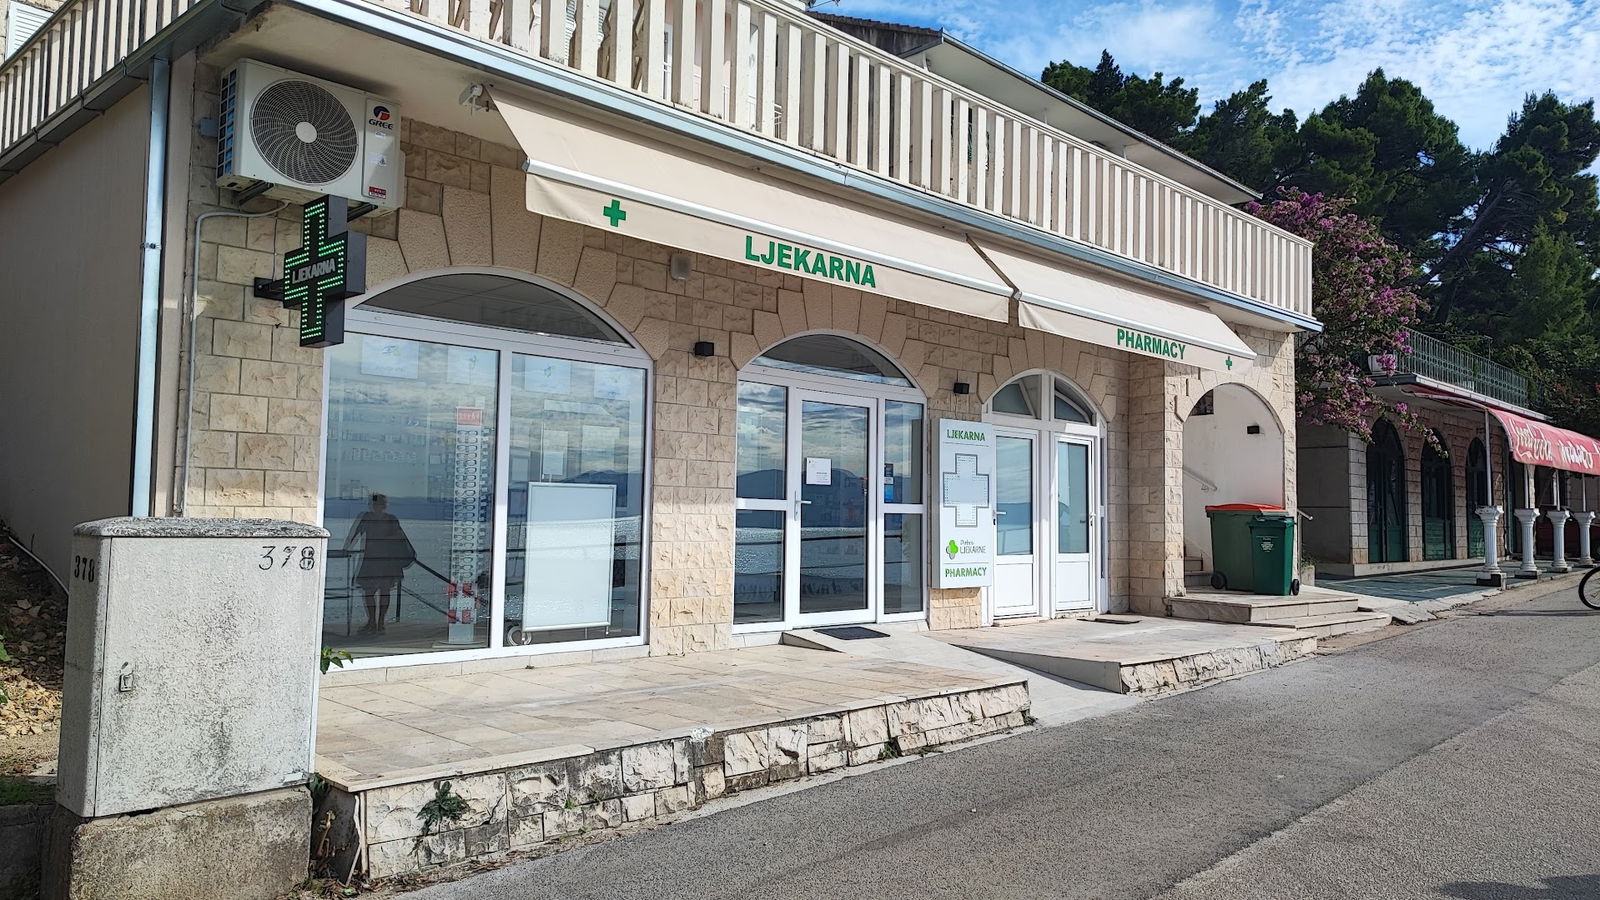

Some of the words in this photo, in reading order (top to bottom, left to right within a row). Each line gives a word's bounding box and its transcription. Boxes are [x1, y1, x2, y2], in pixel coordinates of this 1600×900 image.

[368, 118, 394, 131] GREE
[292, 257, 336, 284] LJEKARNA
[745, 235, 876, 289] LJEKARNA
[1117, 328, 1186, 360] PHARMACY
[946, 429, 986, 442] LJEKARNA
[258, 545, 316, 571] 378
[959, 545, 987, 554] LJEKARNE
[74, 555, 95, 583] 378
[945, 567, 987, 578] PHARMACY
